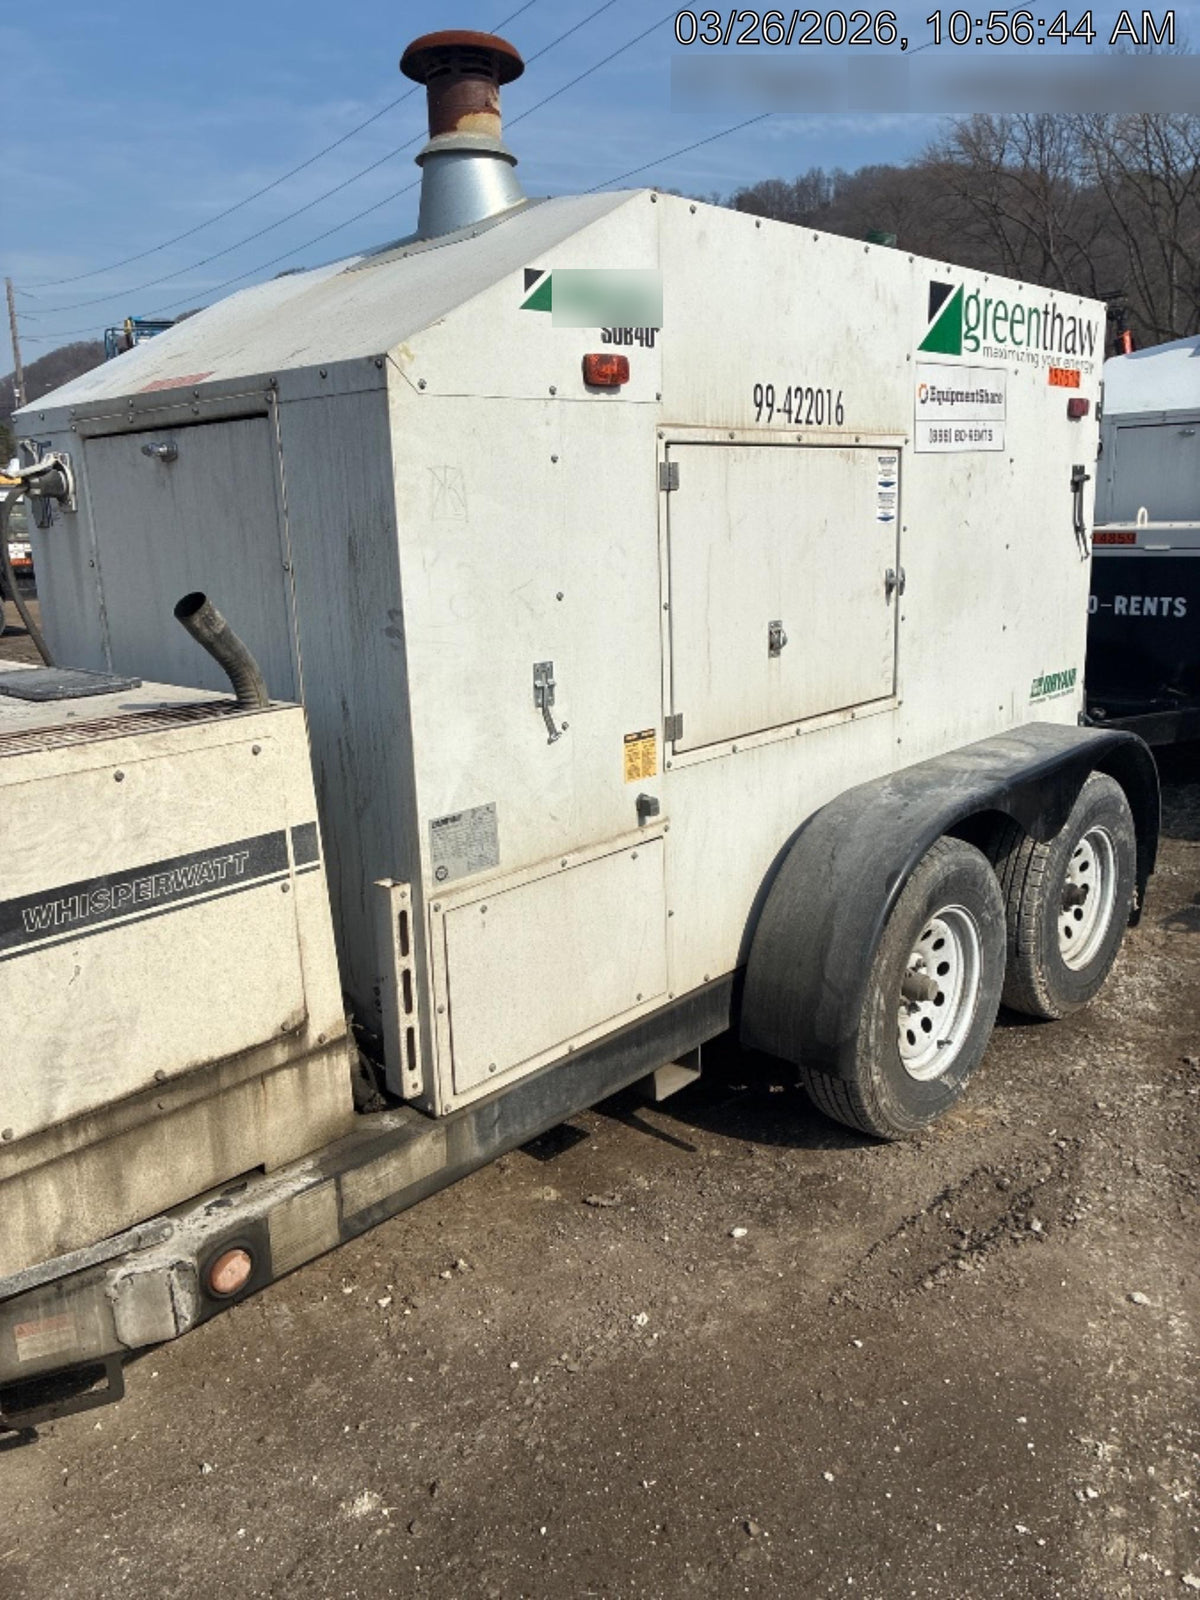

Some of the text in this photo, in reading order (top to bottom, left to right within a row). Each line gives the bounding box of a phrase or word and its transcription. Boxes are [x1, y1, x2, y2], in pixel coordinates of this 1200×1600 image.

[963, 288, 1100, 357] greenthaw
[753, 383, 845, 426] 99-422016
[929, 385, 1004, 406] EquipmentShare
[21, 851, 250, 933] WHISPERWATT
